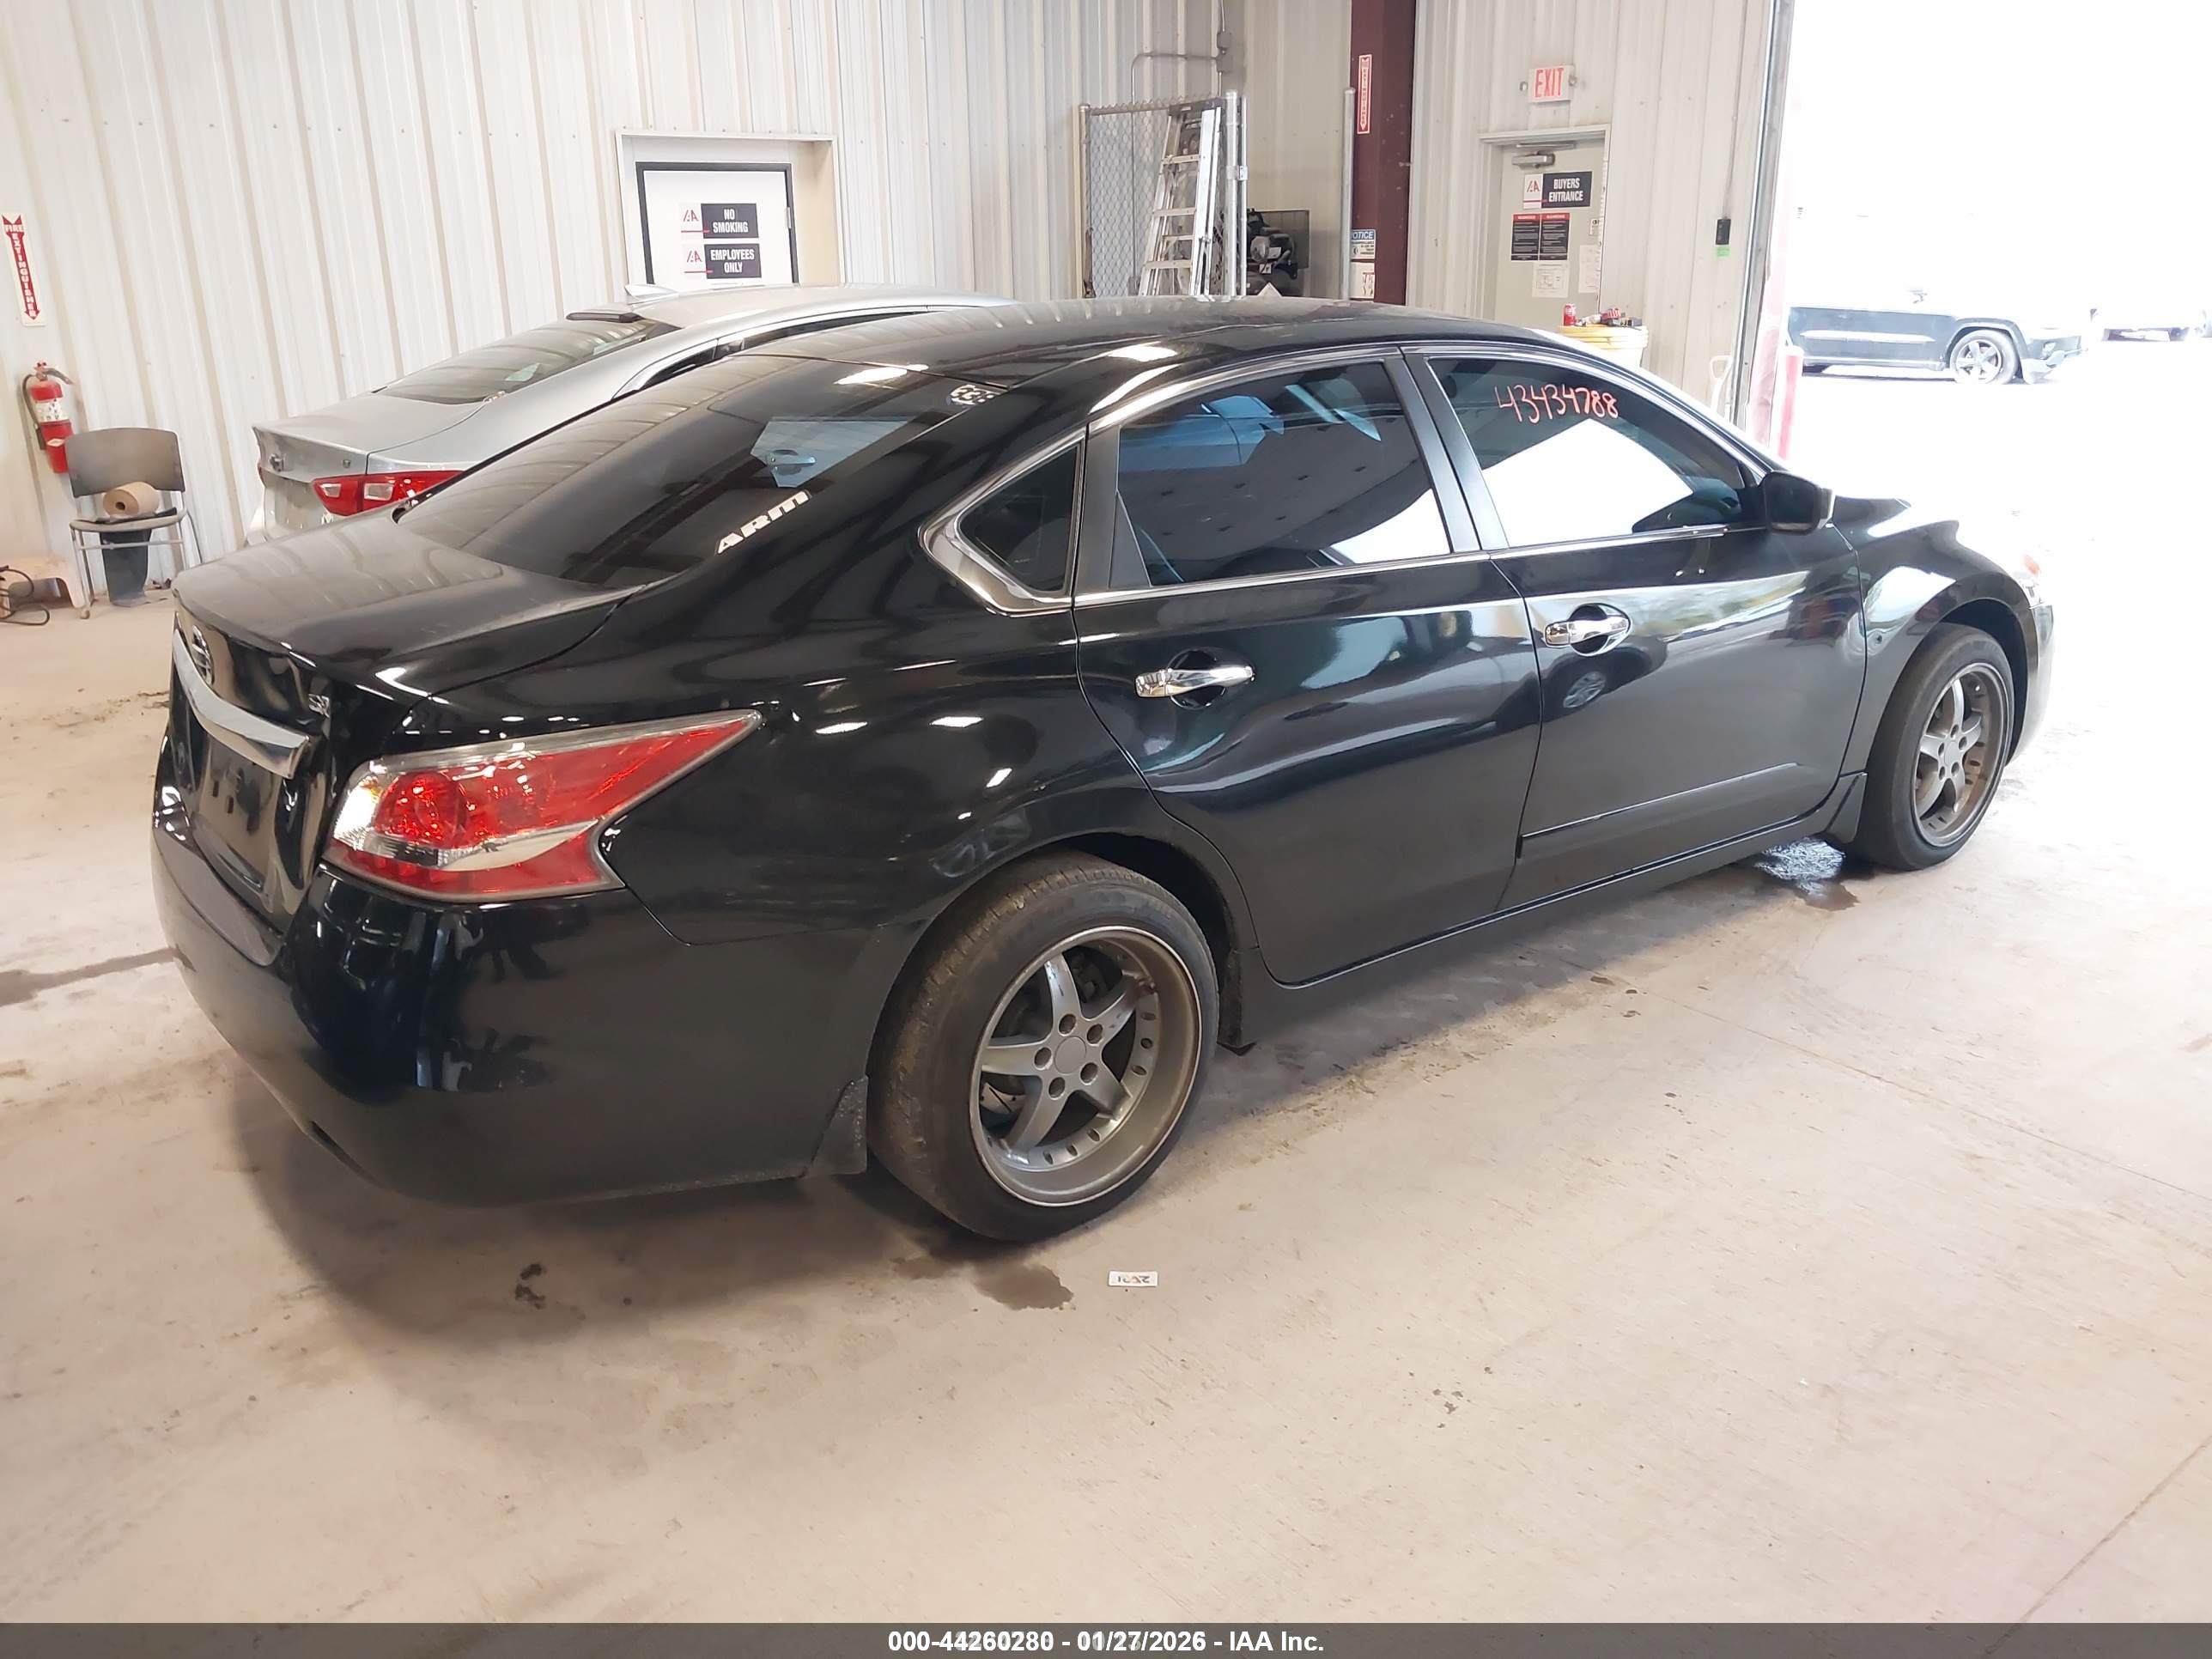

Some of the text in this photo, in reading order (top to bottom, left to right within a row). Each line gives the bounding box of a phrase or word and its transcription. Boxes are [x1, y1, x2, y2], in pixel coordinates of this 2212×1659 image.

[1534, 68, 1564, 97] EXIT
[1553, 178, 1580, 190] BUYERS
[1548, 190, 1583, 203] ENTRANCE
[724, 209, 735, 221] NO
[713, 222, 749, 233] SMOKING
[1352, 231, 1374, 240] OTICE
[710, 249, 755, 260] EMPLOYEES
[724, 262, 743, 273] ONLY
[1494, 384, 1619, 423] 43434788
